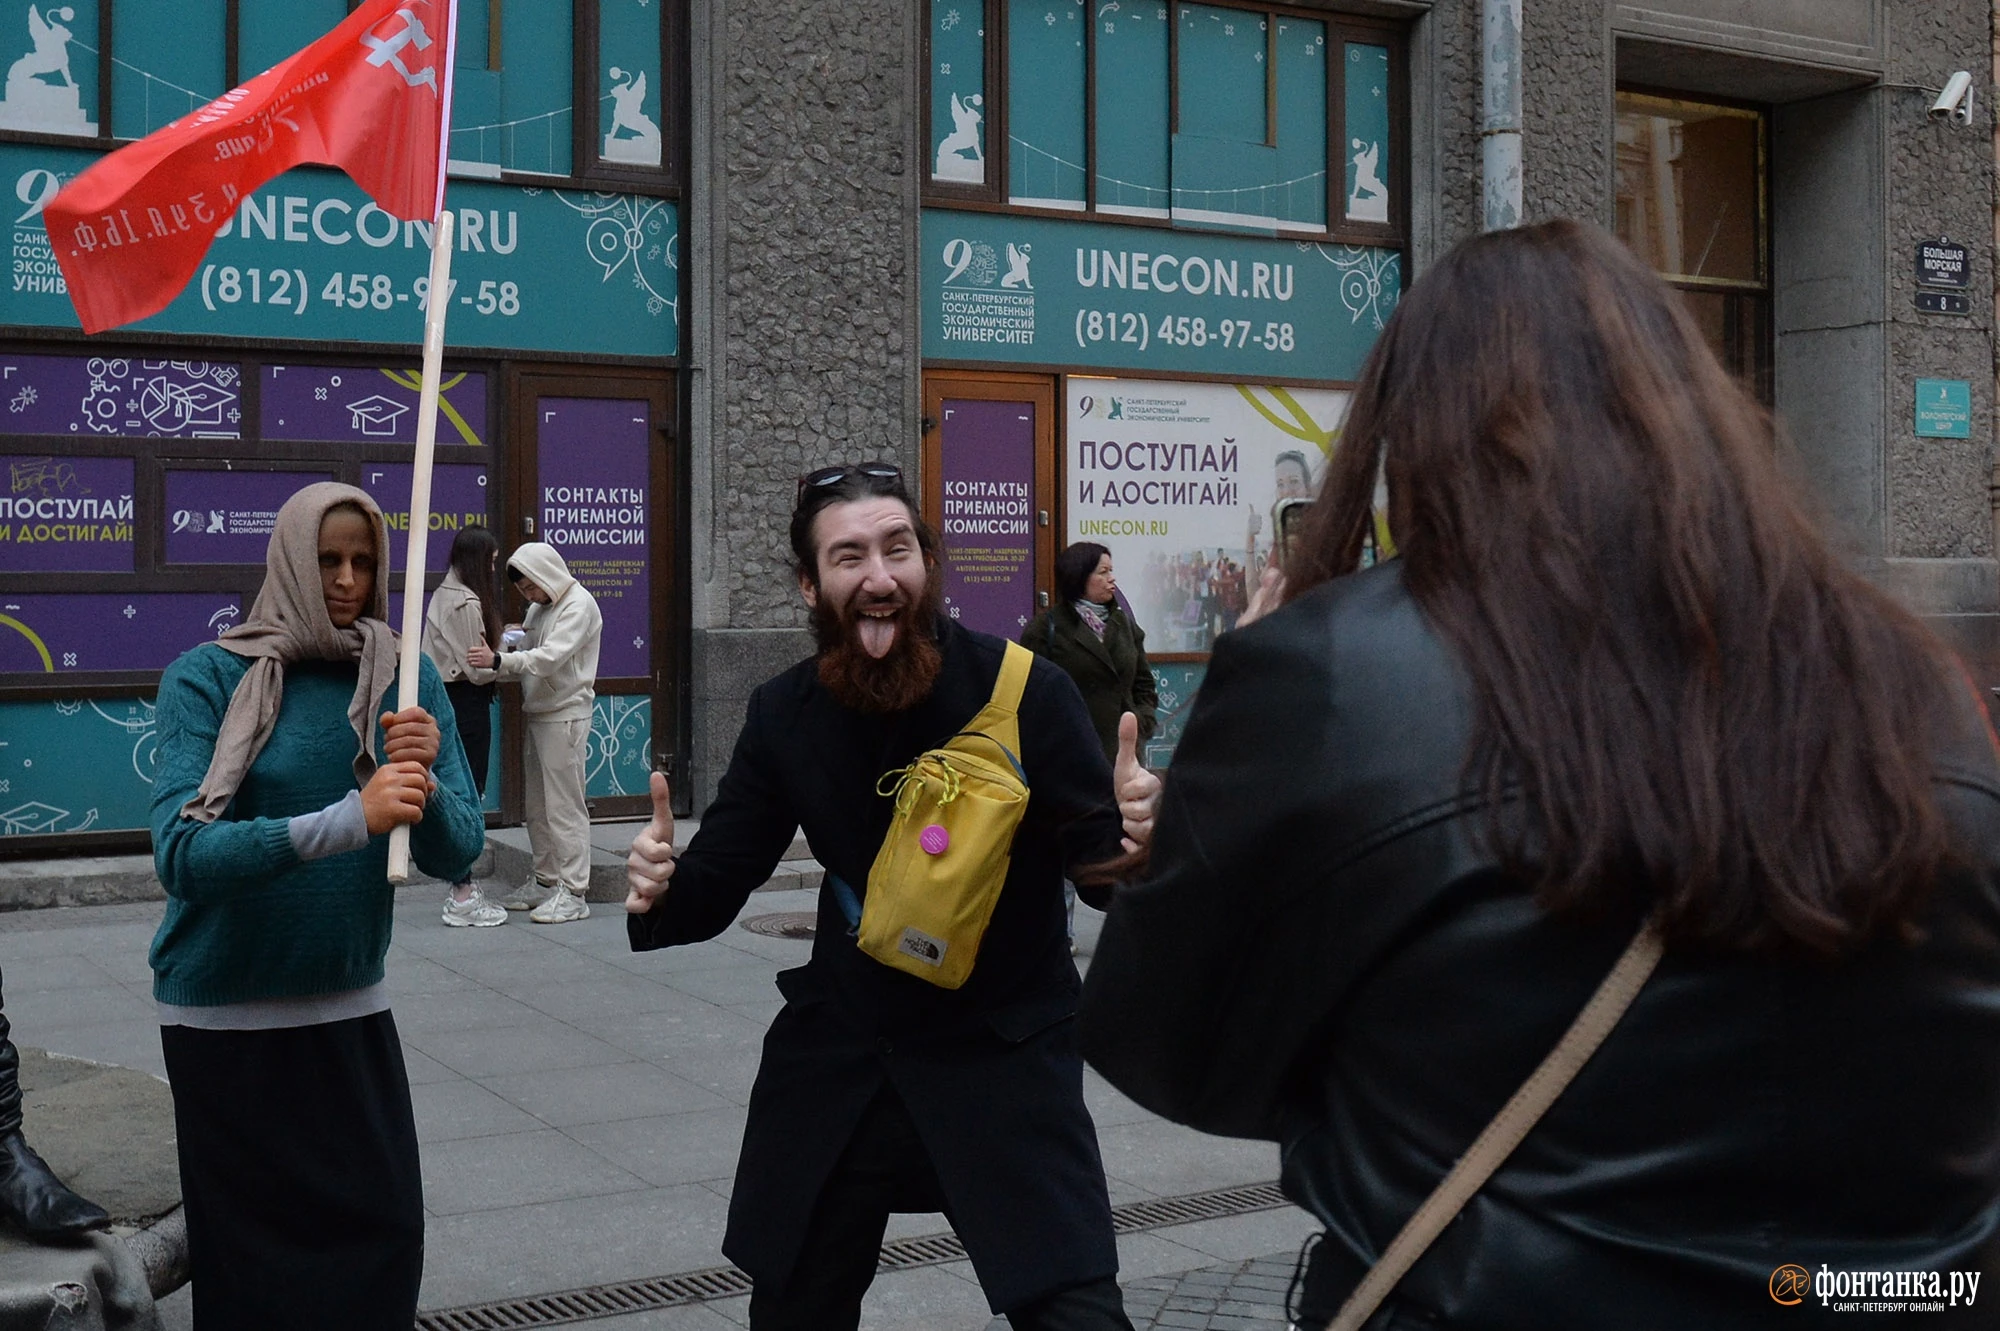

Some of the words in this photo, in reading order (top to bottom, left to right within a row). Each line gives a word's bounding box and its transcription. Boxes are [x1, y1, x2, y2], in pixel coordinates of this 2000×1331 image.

[13, 232, 51, 246] САНК
[1923, 246, 1964, 261] БОЛЬШАЯ
[1924, 259, 1962, 272] МОРСКАЯ
[1076, 248, 1294, 301] UNECON.RU
[201, 265, 308, 316] (812)
[942, 292, 1034, 306] САНКТ-ПЕТЕРБУРГСКИЙ
[942, 302, 1034, 317] ГОСУДАРСТВЕННЫЙ
[1940, 296, 1947, 310] 8
[942, 314, 1034, 329] ЭКОНОМИЧЕСКИЙ
[942, 326, 1034, 344] УНИВЕРСИТЕТ
[1075, 309, 1149, 351] (812)
[1157, 315, 1295, 352] 458-97-58
[1079, 437, 1238, 473] ПОСТУПАЙ
[544, 487, 643, 504] КОНТАКТЫ
[945, 481, 1028, 497] КОНТАКТЫ
[1079, 480, 1094, 504] И
[1101, 476, 1238, 508] ДОСТИГАЙ!
[0, 494, 134, 519] ПОСТУПАЙ
[229, 511, 277, 519] САНКТ-ПЕТЕРБУ
[544, 505, 644, 524] ПРИЕМНОЙ
[945, 498, 1028, 516] ПРИЕМНОЙ
[229, 519, 275, 527] ГОСУДАРСТВЕ
[944, 519, 1029, 535] КОМИССИИ
[1079, 519, 1169, 537] UNECON.RU
[0, 524, 11, 541] И
[16, 521, 134, 543] ДОСТИГАЙ!
[543, 528, 645, 545] КОМИССИИ
